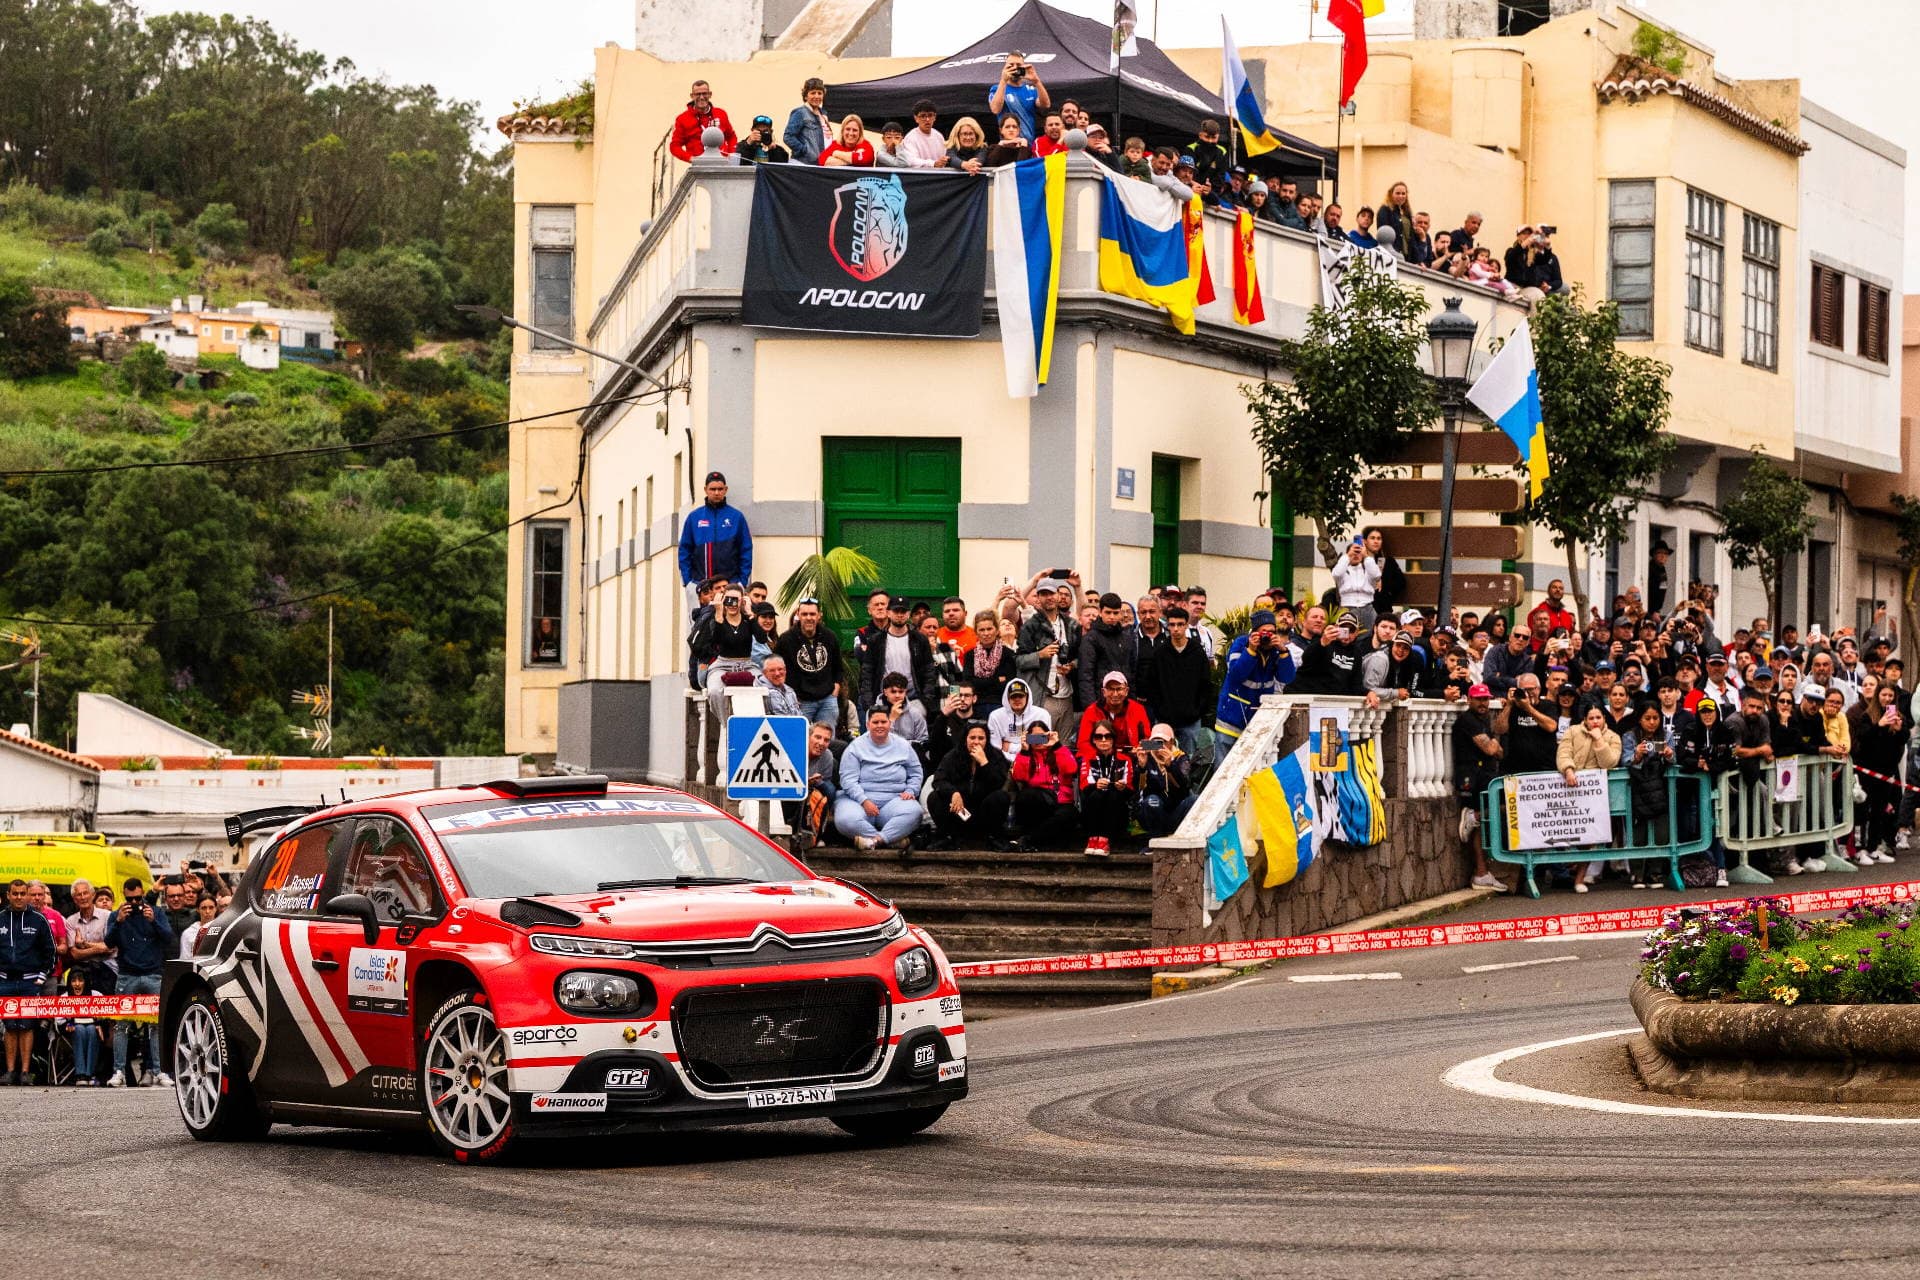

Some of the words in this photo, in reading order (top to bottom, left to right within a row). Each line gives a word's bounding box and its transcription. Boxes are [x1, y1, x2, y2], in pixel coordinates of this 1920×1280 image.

[850, 186, 869, 274] APOLOCAN
[799, 287, 925, 310] APOLOCAN
[1520, 788, 1602, 801] RECONOCIMIENTO
[1547, 800, 1576, 808] RALLY
[1509, 796, 1518, 831] AVISO
[1534, 811, 1558, 819] ONLY
[1561, 808, 1590, 817] RALLY
[1532, 817, 1595, 828] RECOGNITION
[1541, 827, 1587, 837] VEHICLES
[263, 839, 299, 890] 20
[1829, 889, 1862, 899] PROHIBIDO
[1865, 886, 1891, 897] PUBLICO
[1810, 902, 1830, 910] NO-GO
[1832, 900, 1848, 908] AREA
[1598, 912, 1630, 921] PROHIBIDO
[1633, 909, 1658, 918] PUBLICO
[1482, 922, 1514, 931] PROHIBIDO
[1518, 919, 1543, 928] PUBLICO
[1579, 924, 1599, 932] NO-GO
[1601, 922, 1617, 930] AREA
[1621, 920, 1630, 928] NO
[1631, 919, 1658, 927] GO-AREA
[1368, 931, 1400, 939] PROHIBIDO
[1403, 929, 1428, 937] PUBLICO
[1464, 932, 1483, 942] NO-GO
[1485, 931, 1501, 939] AREA
[1506, 930, 1514, 938] NO
[1516, 928, 1543, 938] GO-AREA
[1254, 939, 1286, 948] PROHIBIDO
[1289, 937, 1314, 946] PUBLICO
[1350, 942, 1369, 950] NO-GO
[1371, 940, 1387, 949] AREA
[1391, 939, 1399, 947] NO
[1401, 937, 1428, 946] GO-AREA
[1141, 948, 1172, 957] PROHIBIDO
[1175, 946, 1200, 955] PUBLICO
[1236, 950, 1255, 959] NO-GO
[1257, 949, 1272, 958] AREA
[1277, 948, 1285, 956] NO
[1286, 946, 1313, 955] GO-AREA
[370, 955, 386, 968] Islas
[1123, 958, 1141, 966] NO-GO
[1143, 956, 1159, 965] AREA
[1173, 954, 1200, 963] GO-AREA
[952, 968, 974, 976] O-AREA
[1009, 965, 1028, 973] NO-GO
[1030, 964, 1046, 972] AREA
[1060, 961, 1087, 970] GO-AREA
[355, 966, 385, 981] Canarias
[58, 997, 90, 1005] PROHIBIDO
[38, 1007, 57, 1015] NO-GO
[59, 1007, 76, 1015] AREA
[80, 1007, 88, 1015] NO
[90, 1006, 116, 1014] GO-AREA
[513, 1026, 577, 1045] sparco
[608, 1069, 649, 1085] GT2i
[373, 1091, 415, 1101] RACIN
[754, 1088, 828, 1106] HB-275-NY
